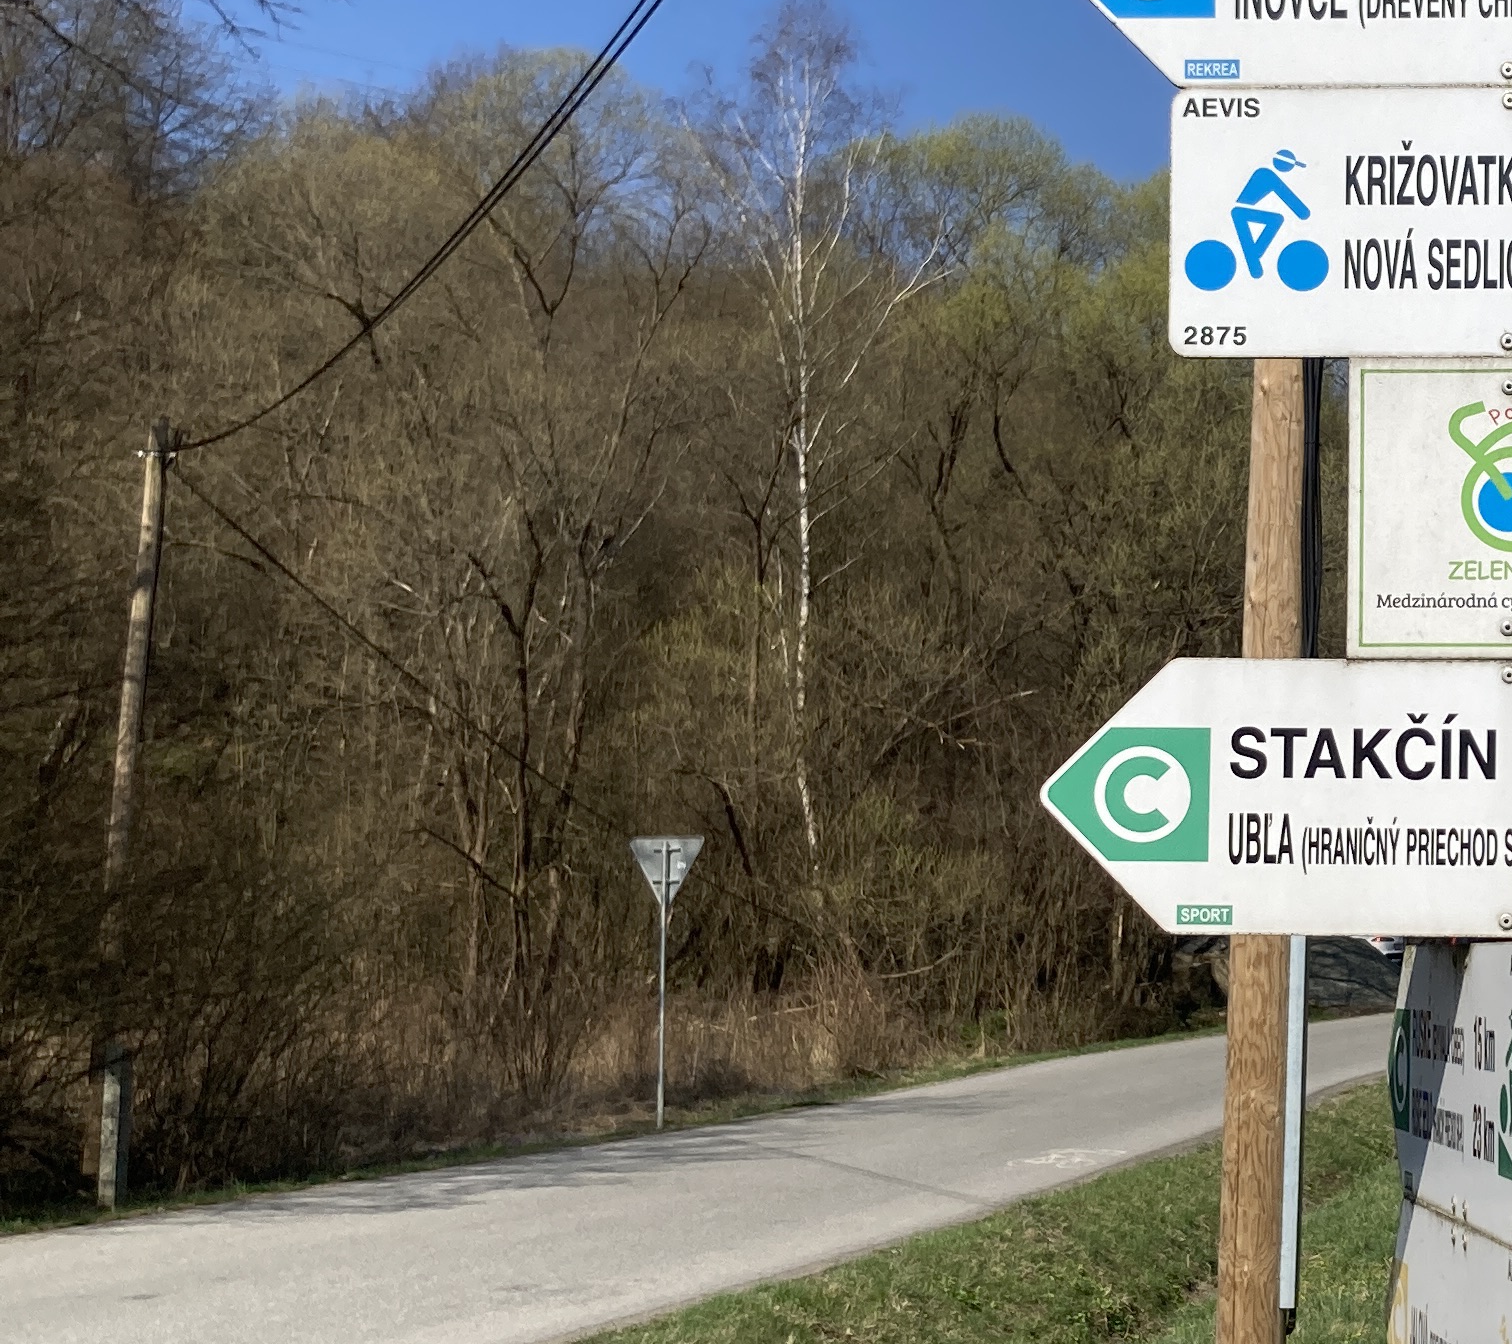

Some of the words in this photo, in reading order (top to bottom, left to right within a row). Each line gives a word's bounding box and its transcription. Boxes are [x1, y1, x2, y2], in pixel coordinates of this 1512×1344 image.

[1188, 64, 1238, 77] REKREA
[1183, 98, 1259, 117] AEVIS
[1345, 228, 1417, 290] NOVÁ
[1185, 326, 1246, 345] 2875
[1377, 593, 1497, 608] Medzinárodná
[1230, 713, 1496, 780] STAKČÍN
[1229, 813, 1293, 864] UBĽA
[1302, 817, 1400, 874] (HRANIČNÝ
[1407, 828, 1497, 866] PRIECHOD
[1181, 908, 1229, 922] SPORT
